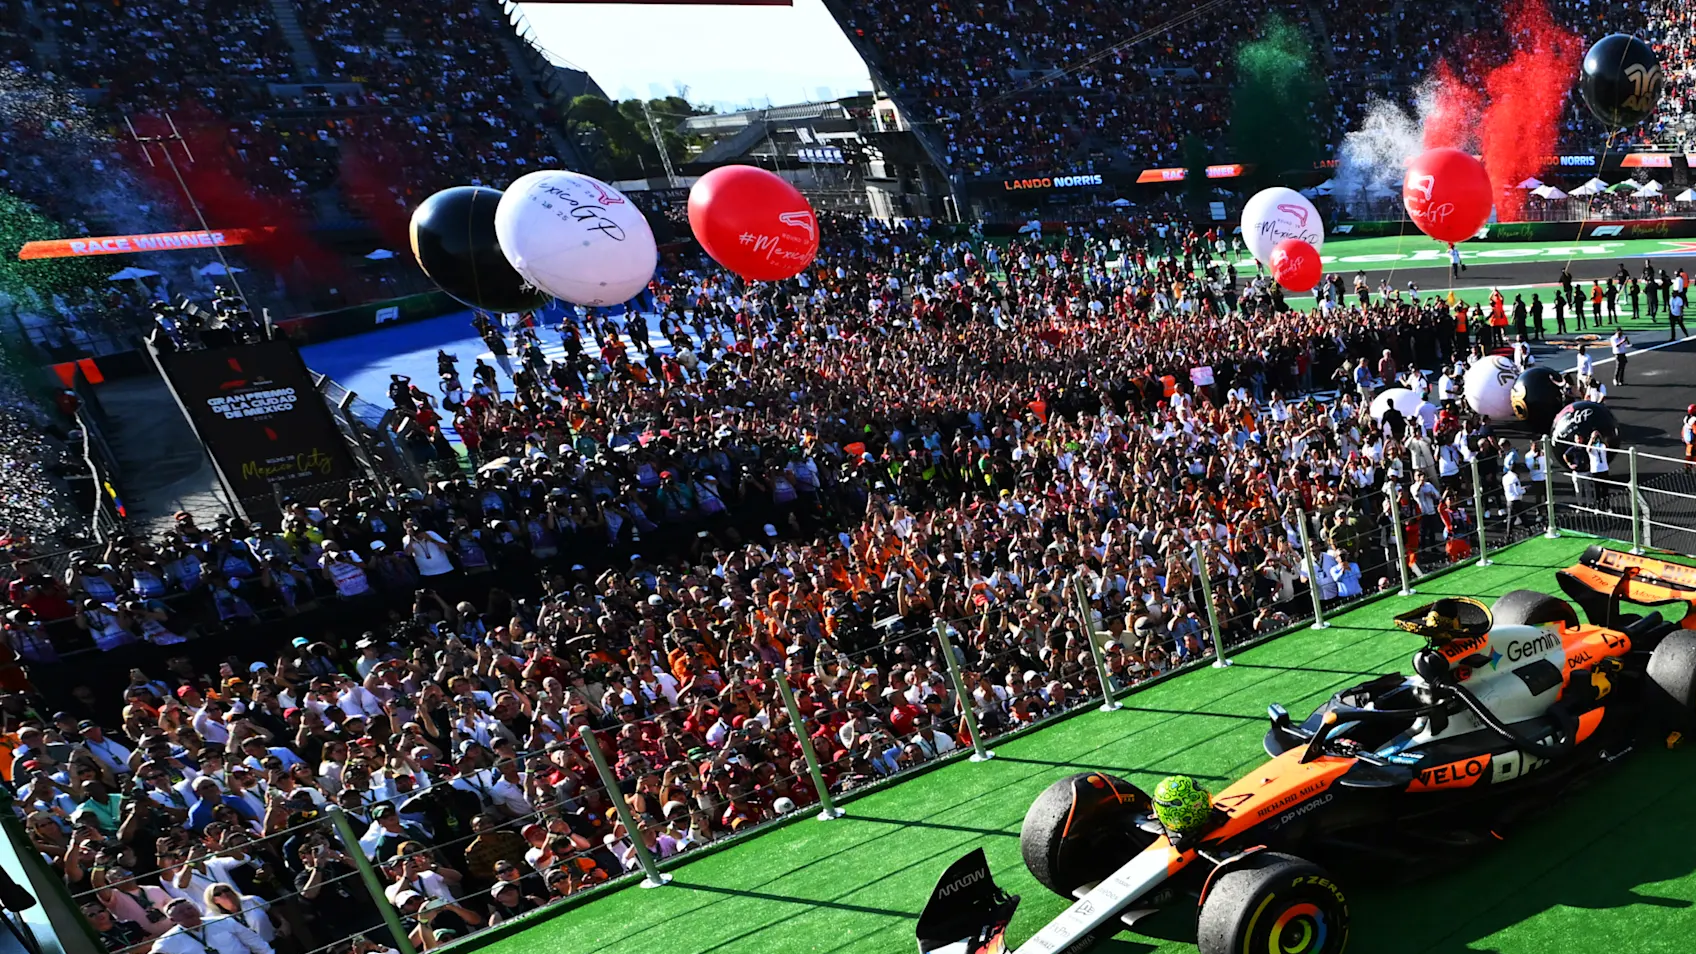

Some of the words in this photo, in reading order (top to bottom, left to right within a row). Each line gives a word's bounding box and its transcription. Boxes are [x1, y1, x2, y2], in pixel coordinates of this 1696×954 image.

[1560, 155, 1595, 167] NORRIS
[1641, 156, 1667, 166] RACE
[1004, 178, 1051, 191] LANDO
[1054, 174, 1102, 187] NORRIS
[70, 238, 128, 254] RACE
[133, 232, 226, 249] WINNER
[207, 393, 247, 407] GRAN
[247, 388, 296, 402] PREMIO
[212, 402, 233, 413] DE
[234, 400, 250, 411] LA
[251, 395, 297, 408] CIUDAD
[224, 409, 243, 420] DE
[244, 403, 293, 417] MEXICO
[242, 460, 294, 480] Mexico
[297, 448, 333, 474] City
[1507, 631, 1561, 662] Gemini
[1568, 652, 1593, 669] DELL
[1419, 759, 1482, 787] VELO
[1257, 793, 1298, 818] RICHARD
[1299, 779, 1327, 797] MILLE
[1281, 811, 1296, 825] DP
[1295, 793, 1334, 816] WORLD
[1291, 877, 1303, 887] P
[1307, 875, 1346, 903] ZERO
